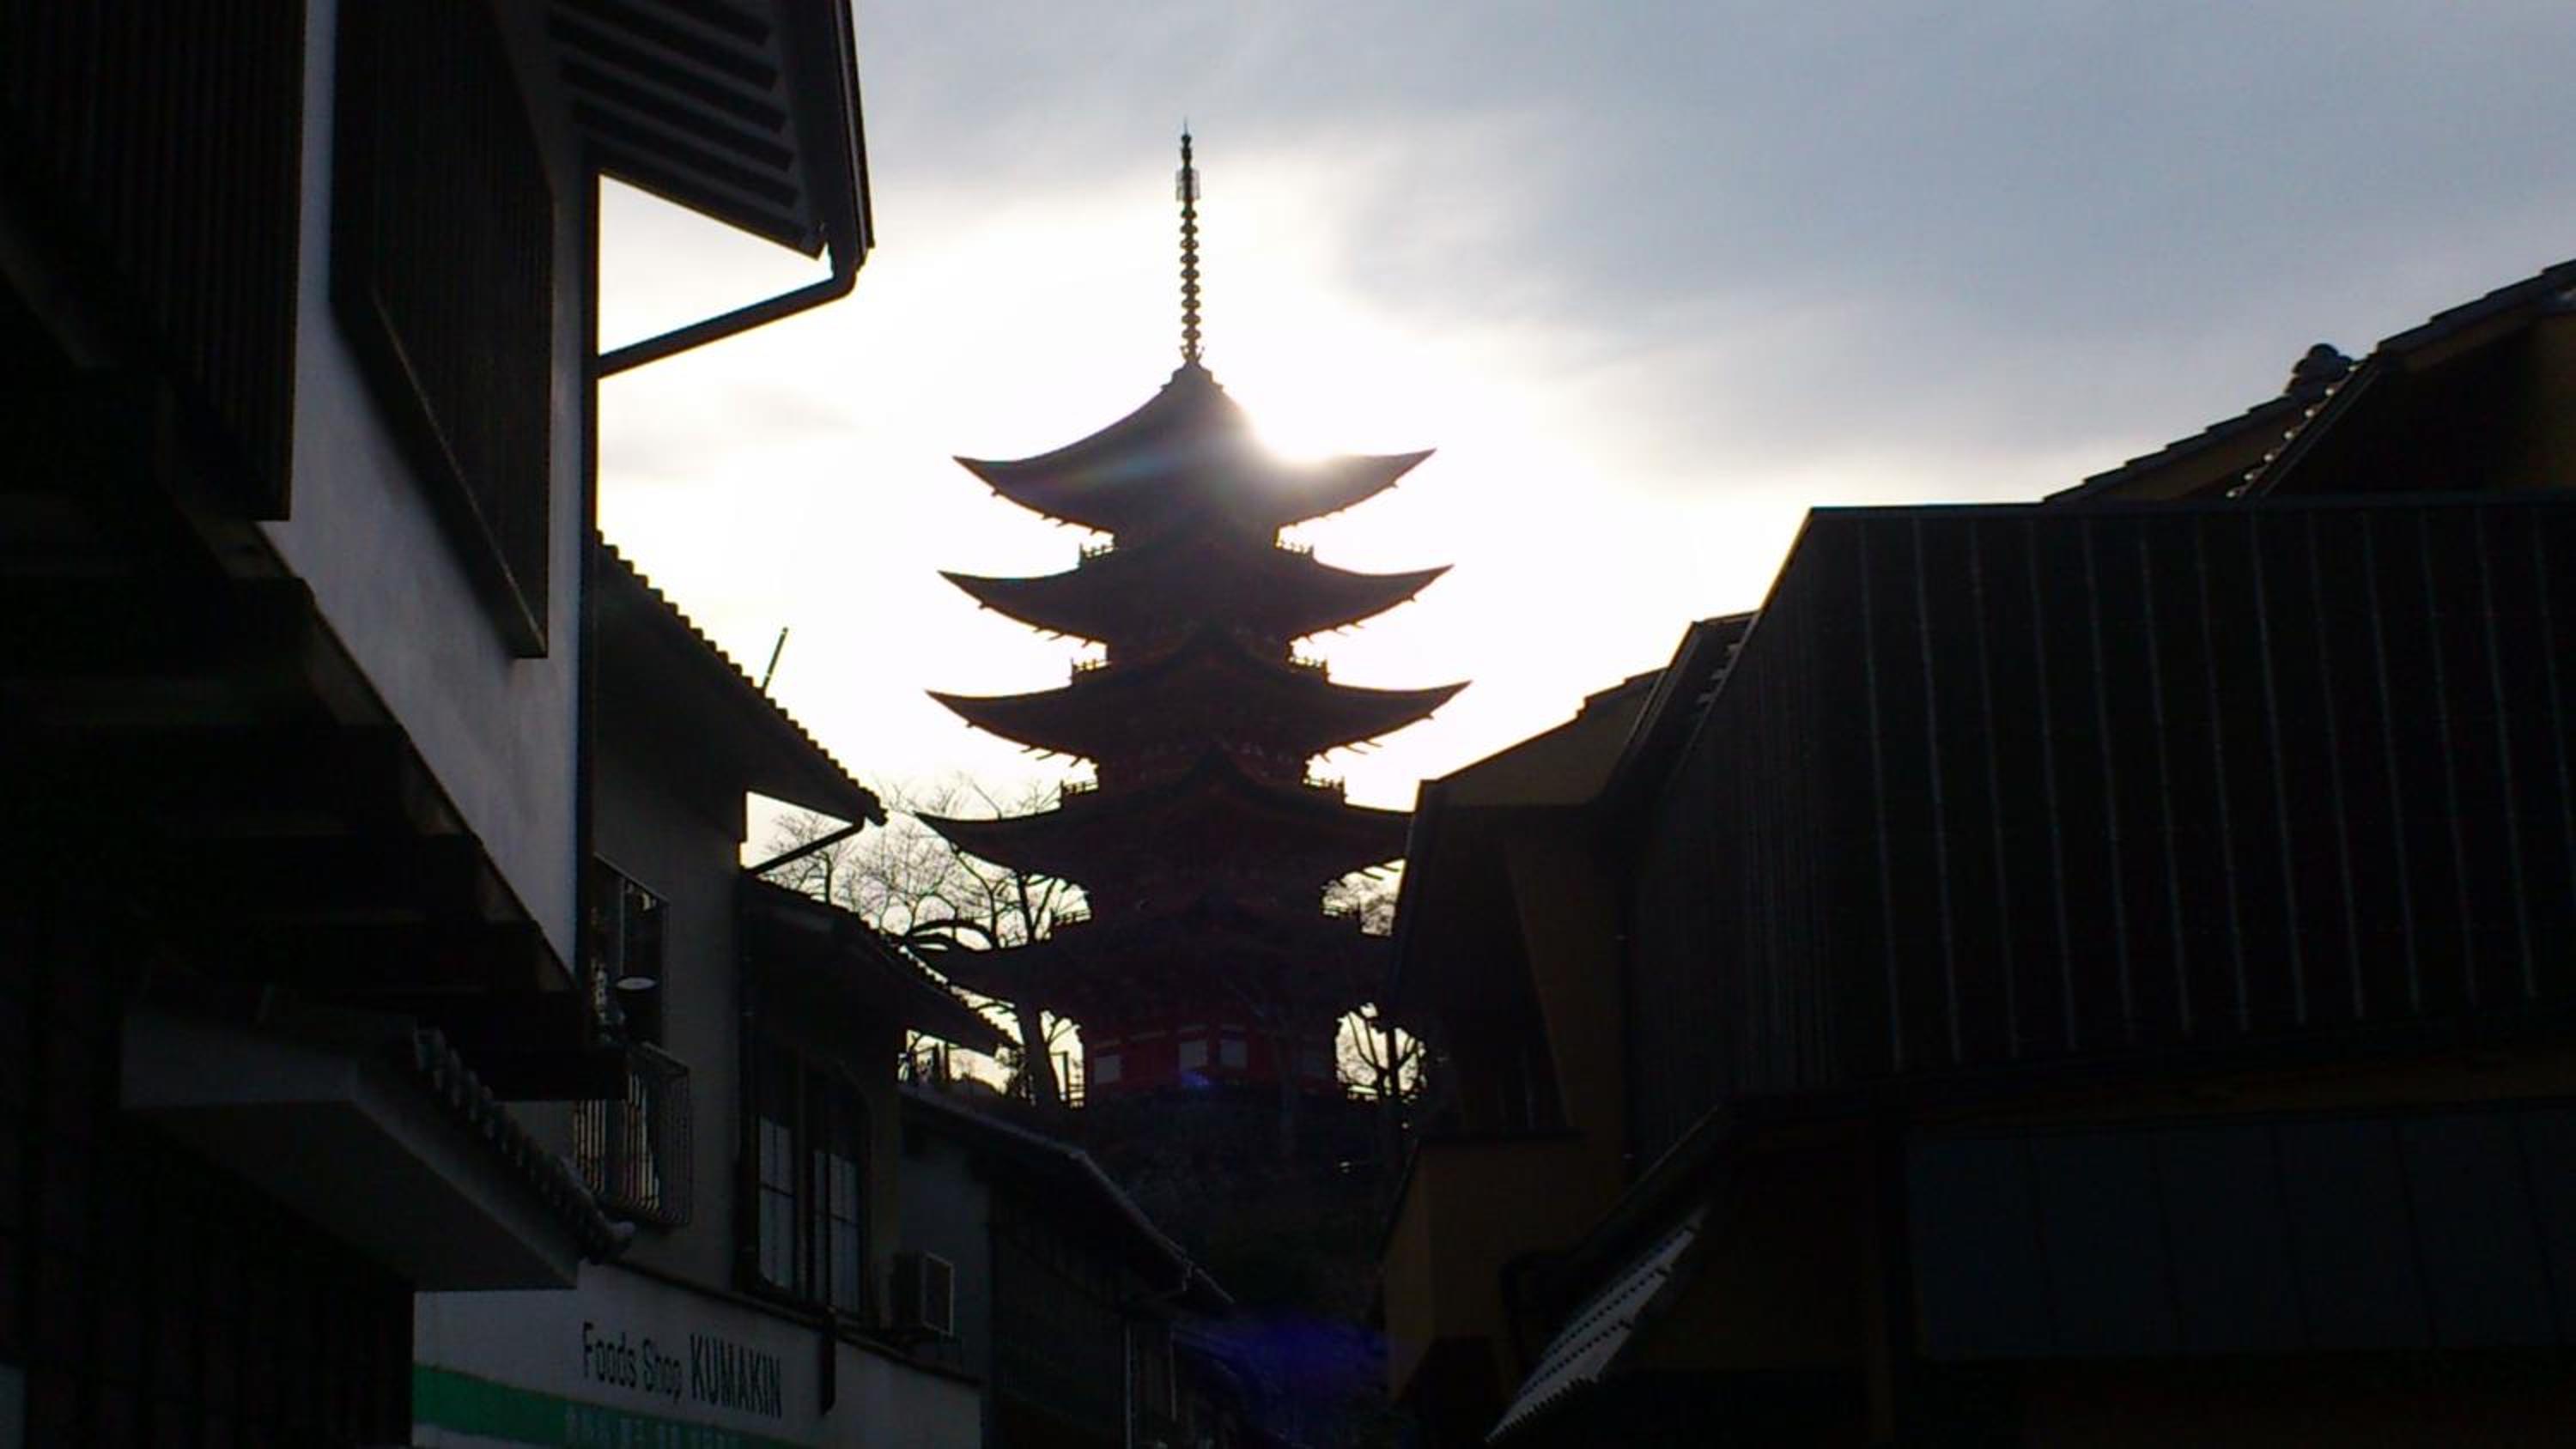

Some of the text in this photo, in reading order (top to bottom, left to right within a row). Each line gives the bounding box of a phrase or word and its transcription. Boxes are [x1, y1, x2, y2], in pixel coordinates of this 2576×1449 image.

[583, 1322, 782, 1418] Foods Shop KUMAKIN
